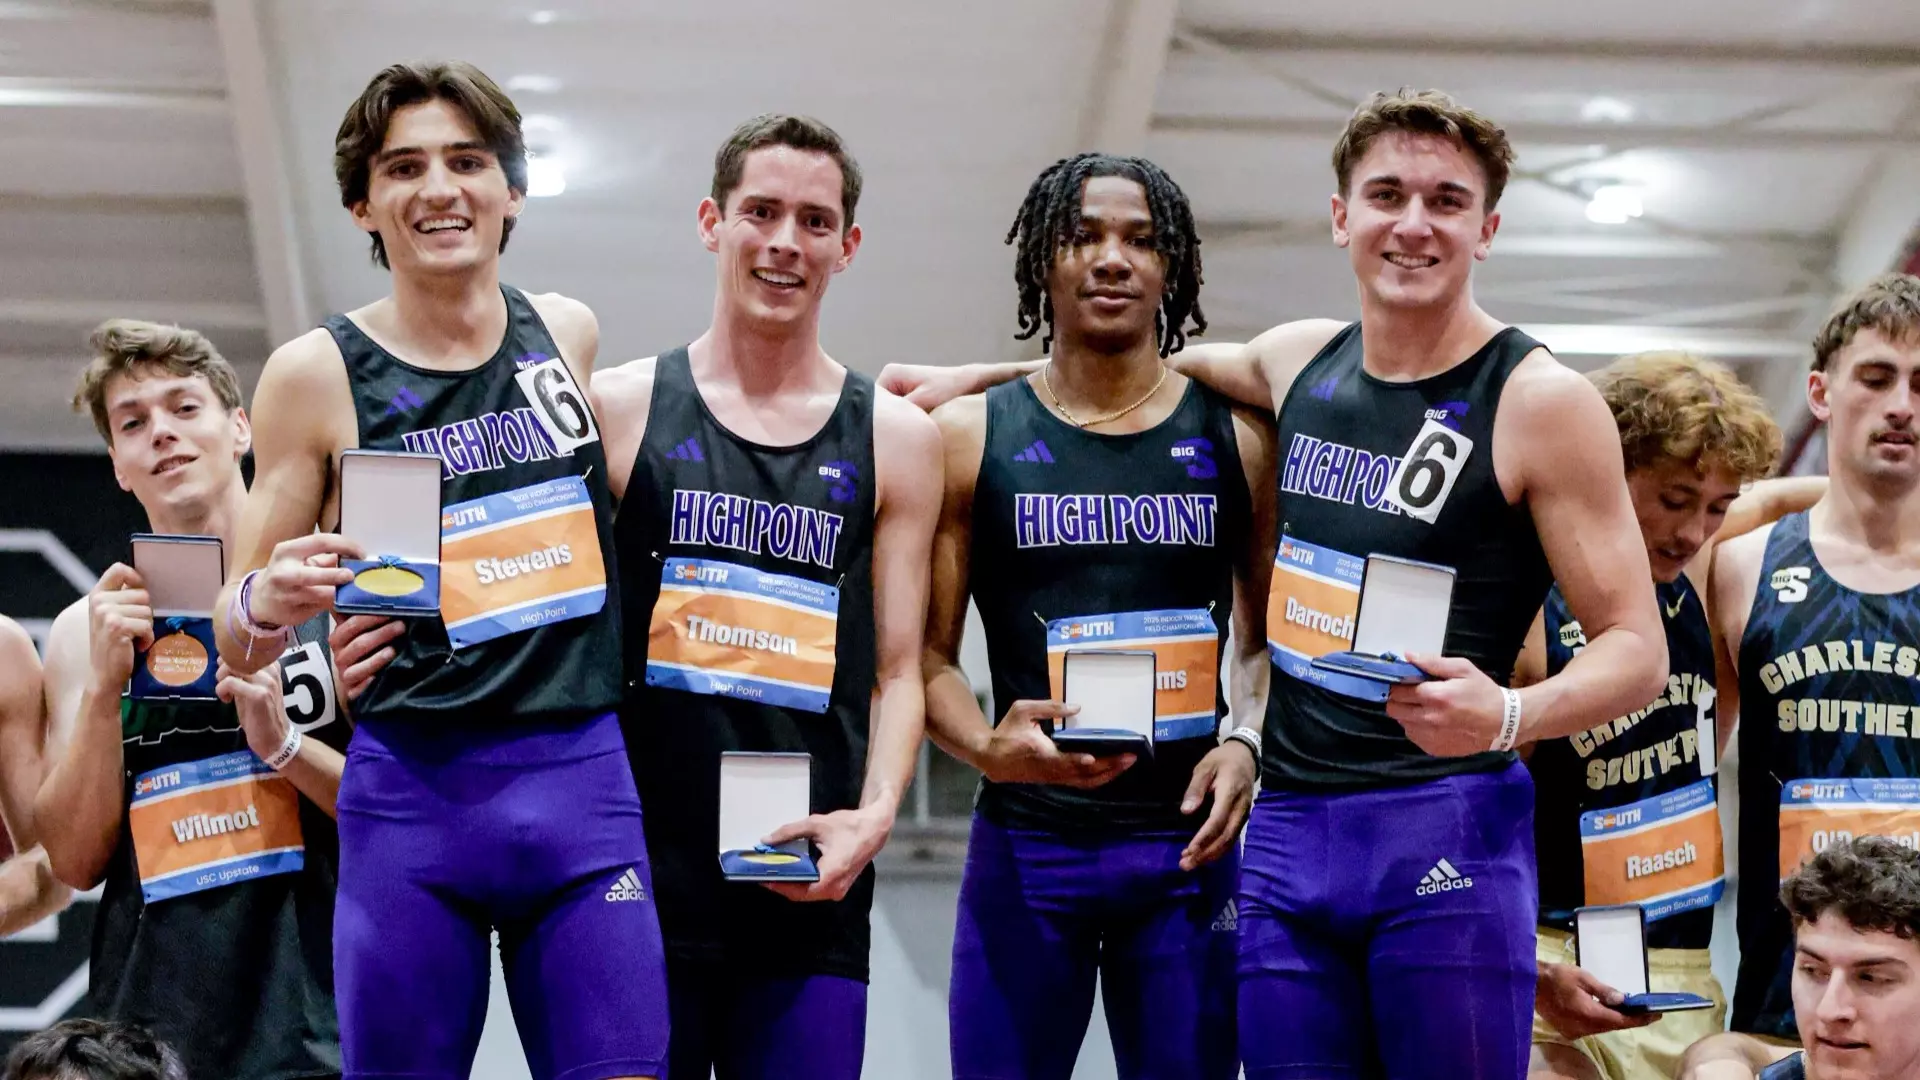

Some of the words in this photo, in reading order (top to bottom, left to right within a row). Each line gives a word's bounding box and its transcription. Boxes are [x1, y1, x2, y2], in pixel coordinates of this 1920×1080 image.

[533, 367, 590, 441] 6
[1424, 408, 1448, 420] BIG
[480, 407, 574, 469] POIN
[1171, 446, 1196, 458] BIG
[818, 465, 841, 479] BIG
[1281, 433, 1354, 501] HIGH
[1398, 431, 1457, 508] 6
[670, 489, 749, 551] HIGH
[750, 500, 843, 569] POINT
[1015, 494, 1109, 548] HIGH
[1111, 494, 1218, 547] POINT
[474, 542, 573, 585] Stevens
[520, 608, 543, 625] High
[544, 605, 567, 620] Point
[686, 614, 798, 655] Thomson
[1285, 596, 1354, 641] Darroch
[1292, 663, 1308, 683] High
[1309, 669, 1327, 683] Point
[1759, 639, 1920, 694] CHARLES
[279, 650, 325, 725] 5
[710, 681, 735, 695] High
[736, 684, 763, 698] Point
[1504, 705, 1517, 740] SOUTH
[171, 804, 260, 843] Wilmot
[196, 873, 217, 885] USC
[218, 865, 260, 881] Upstate
[1626, 840, 1697, 880] Raasch
[1415, 877, 1473, 896] adidas
[1673, 894, 1709, 911] Southern
